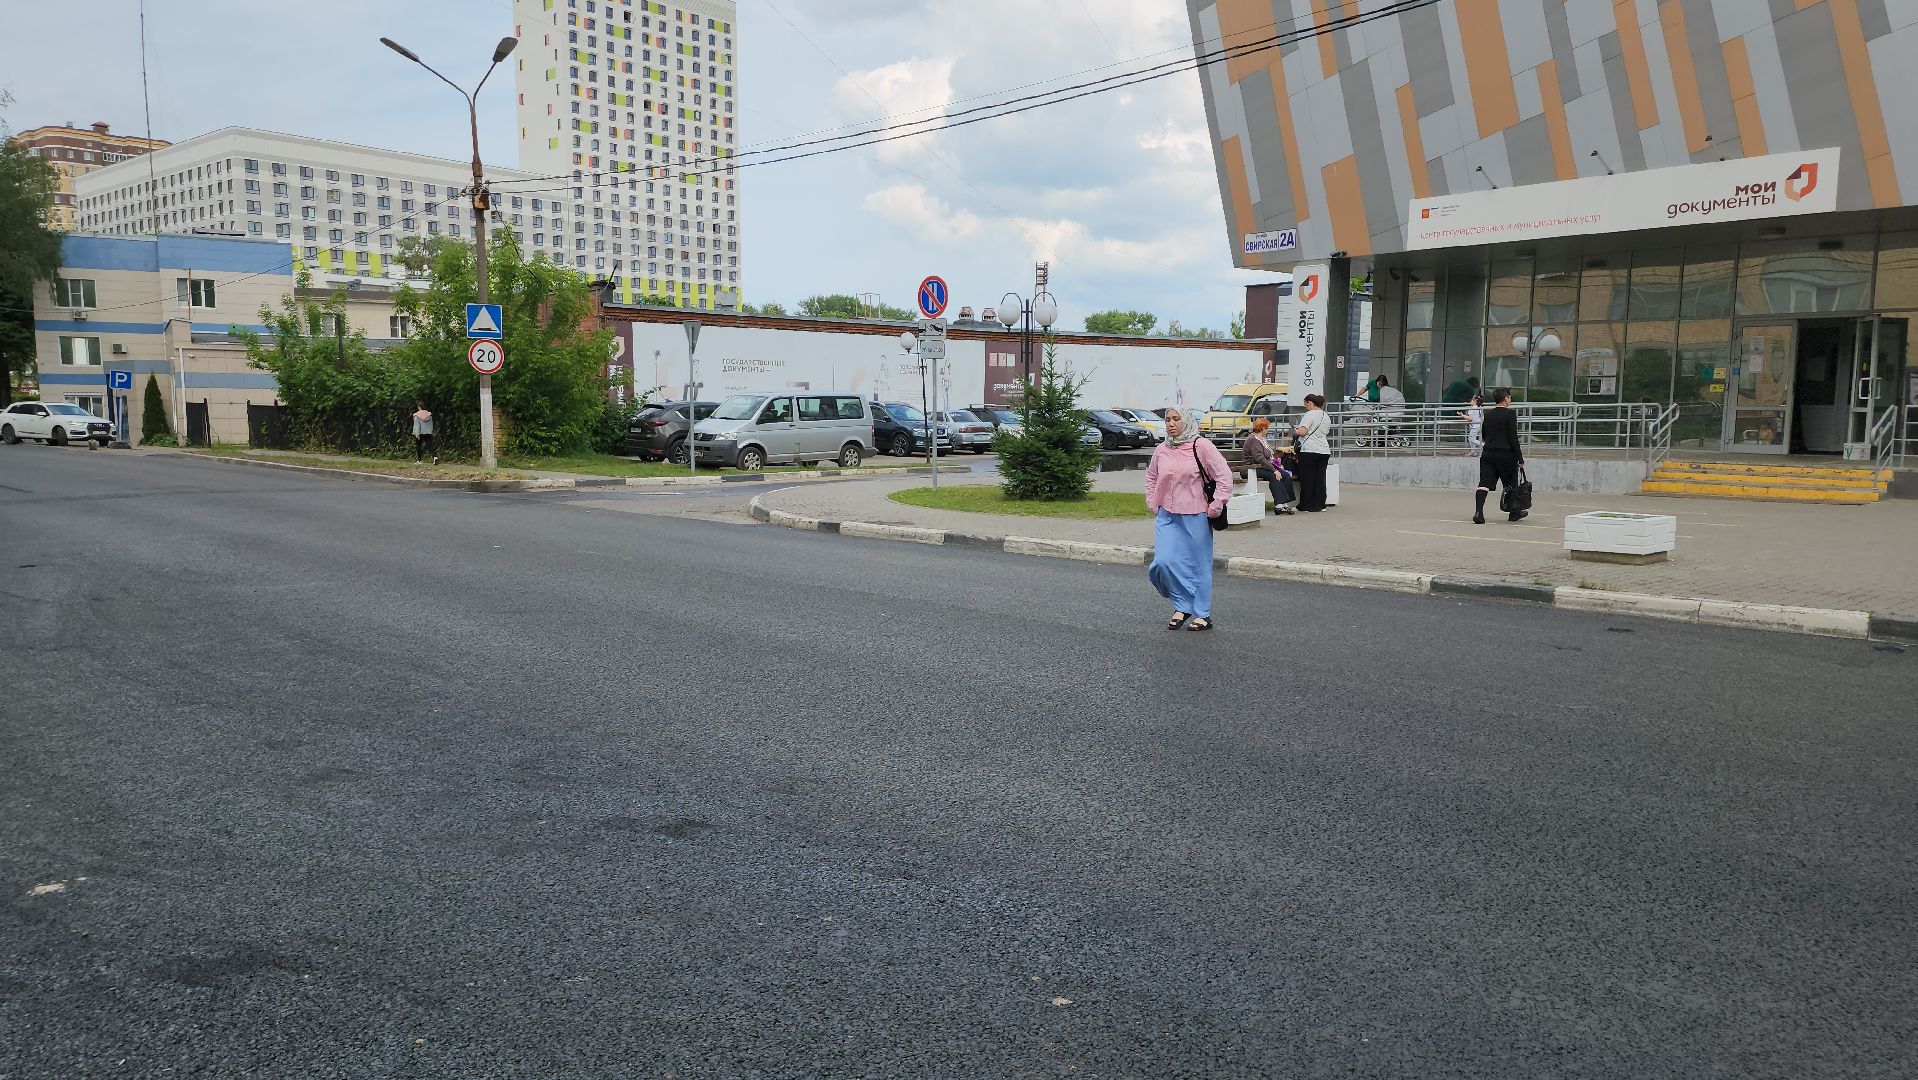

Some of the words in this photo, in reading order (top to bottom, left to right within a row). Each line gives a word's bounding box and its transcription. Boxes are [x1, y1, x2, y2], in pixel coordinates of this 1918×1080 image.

[1735, 181, 1776, 196] мои
[1667, 194, 1776, 219] документы
[1245, 239, 1278, 251] СВИРСКАЯ
[1280, 231, 1295, 247] 2А
[476, 348, 496, 363] 20
[1304, 310, 1316, 387] документы
[722, 365, 765, 373] ДОКУМЕНТЫ
[115, 372, 128, 387] P
